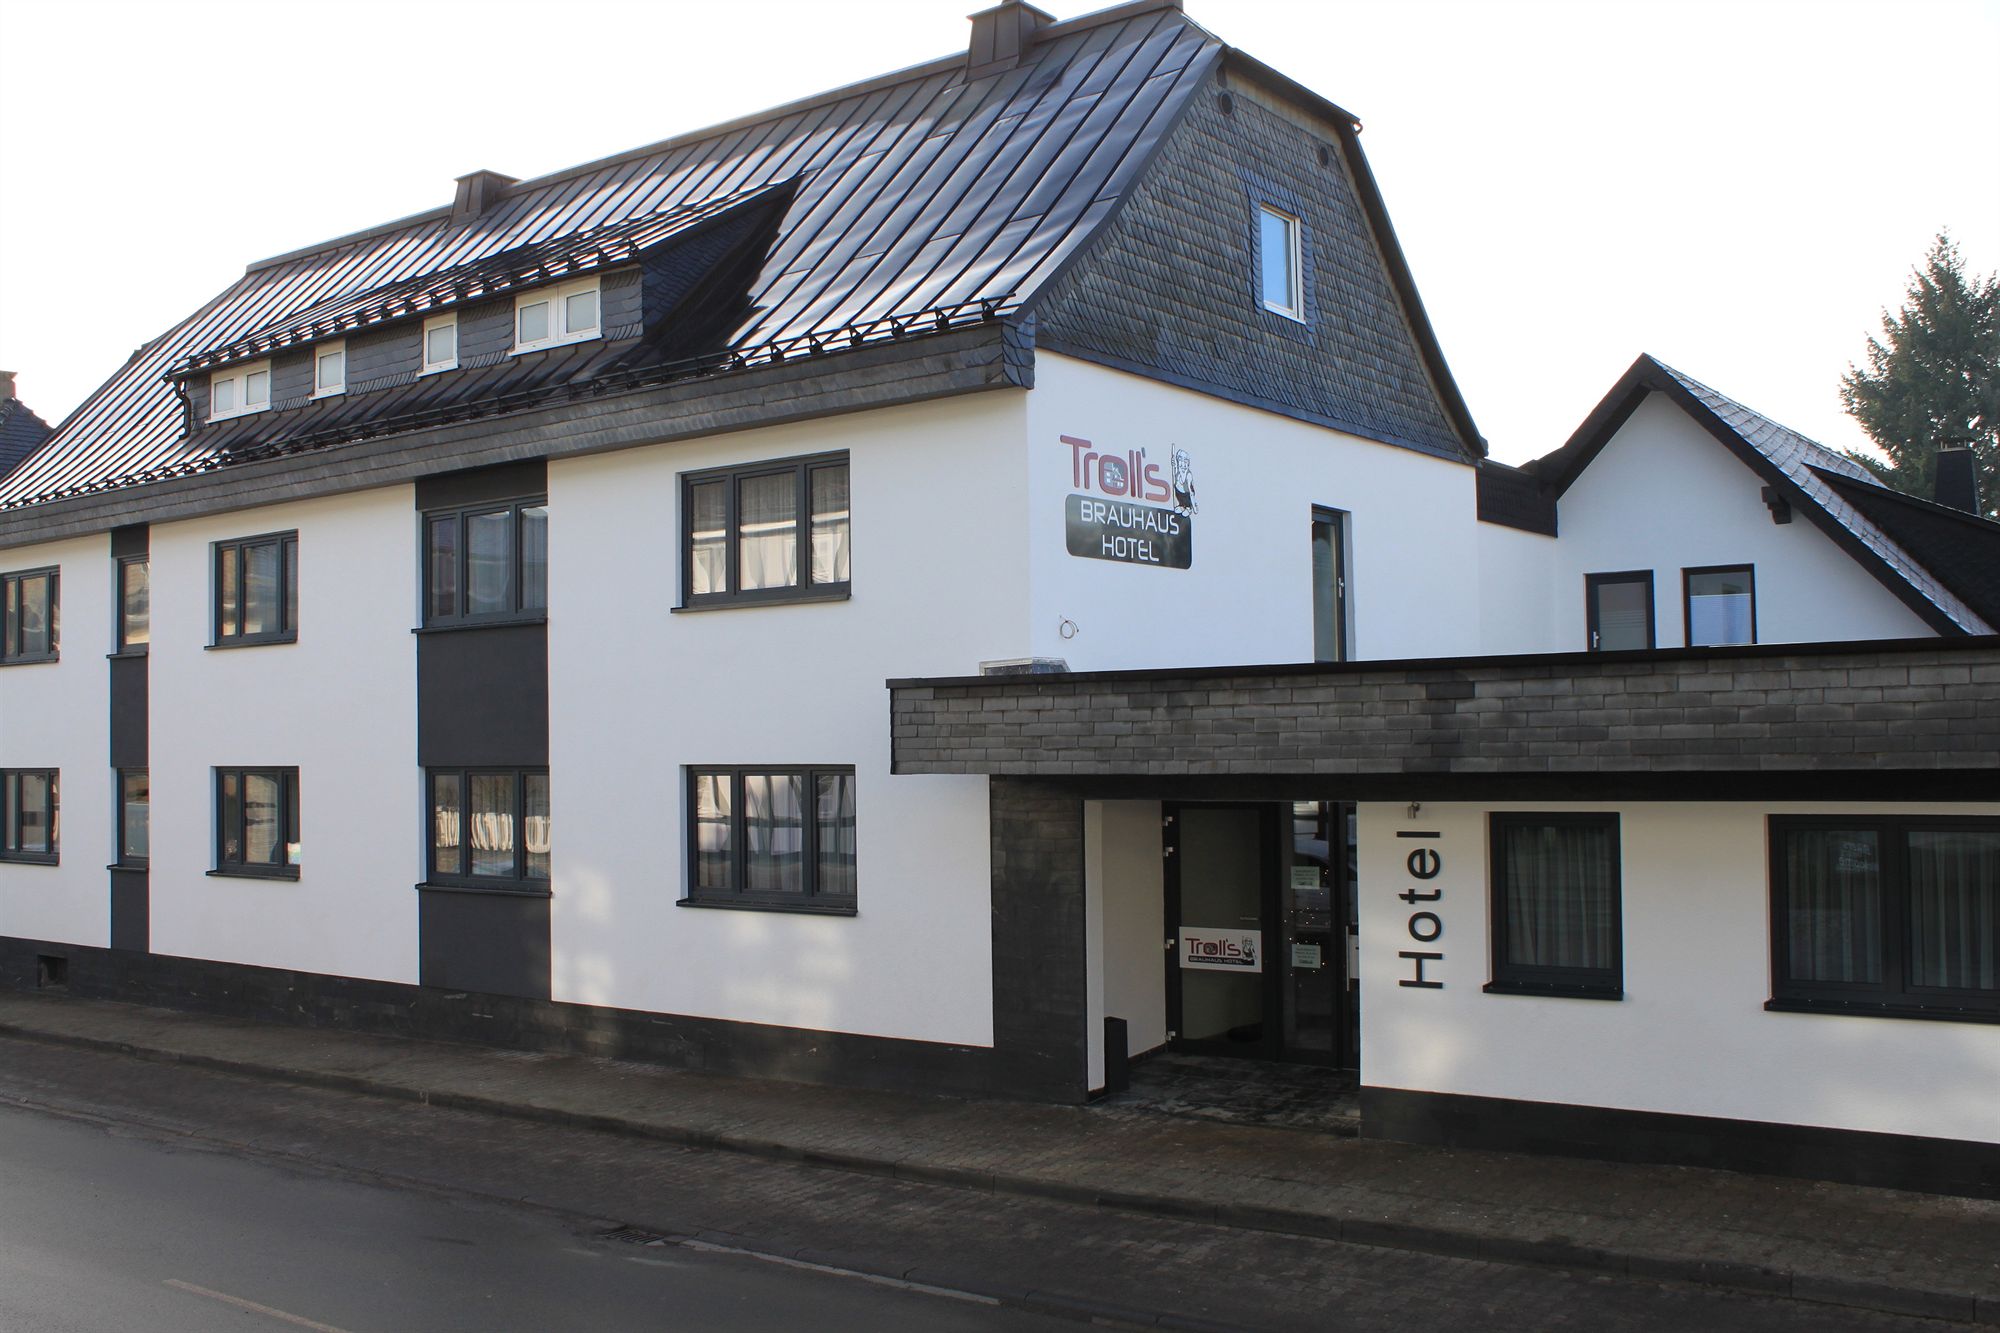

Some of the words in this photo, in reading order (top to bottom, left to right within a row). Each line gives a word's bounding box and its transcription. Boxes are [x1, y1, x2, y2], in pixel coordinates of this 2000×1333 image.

[1060, 435, 1171, 502] Troll's
[1080, 500, 1180, 535] BRAUHAUS
[1102, 534, 1160, 562] HOTEL
[1396, 831, 1443, 989] Hotel
[1185, 937, 1241, 957] Troll's
